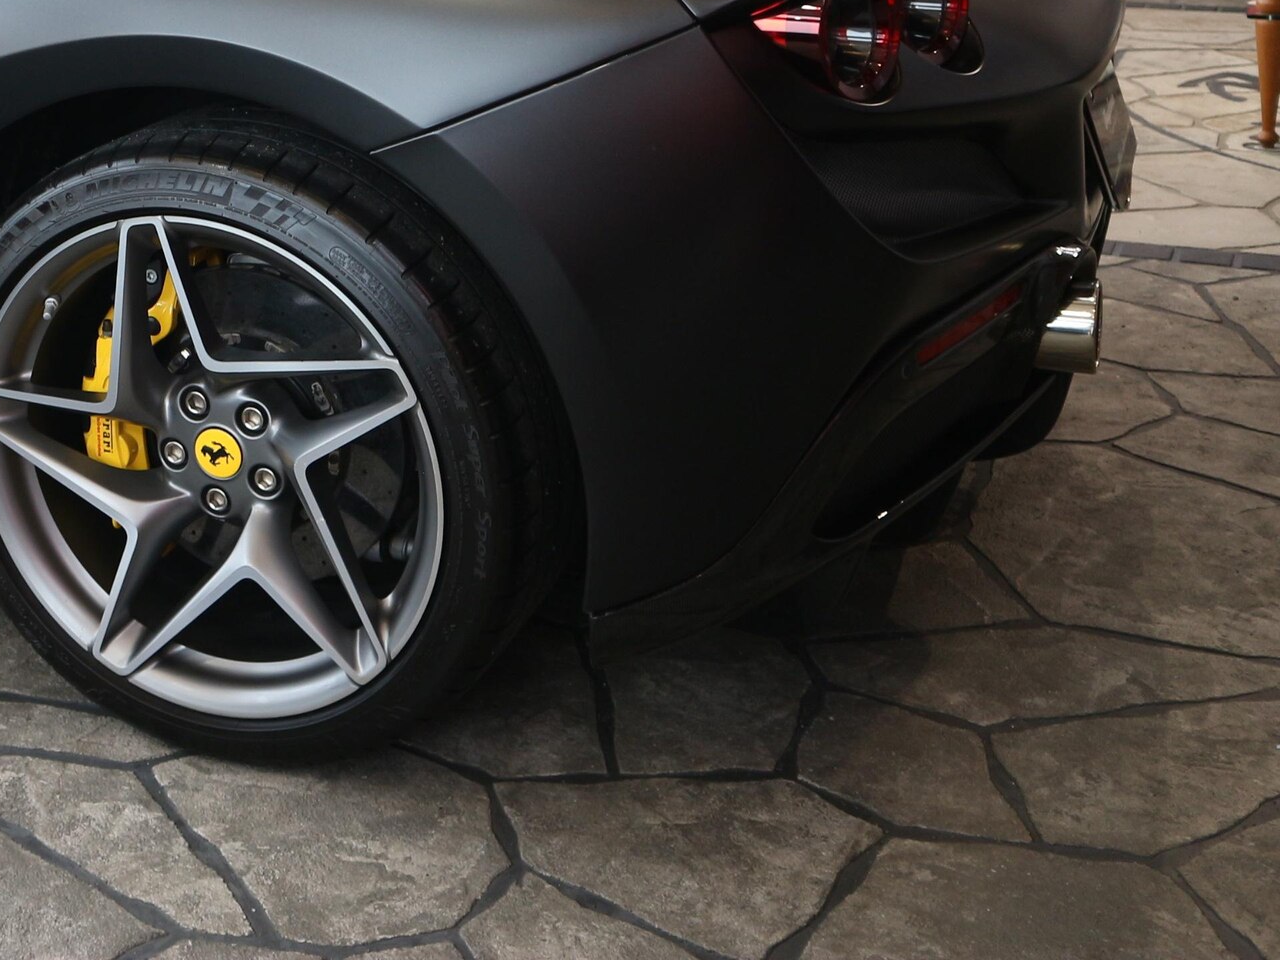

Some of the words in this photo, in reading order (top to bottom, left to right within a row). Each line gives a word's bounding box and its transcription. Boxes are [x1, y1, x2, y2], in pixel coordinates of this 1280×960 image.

[83, 169, 235, 203] MICHELIN
[103, 418, 114, 454] rari
[472, 509, 492, 579] Sport
